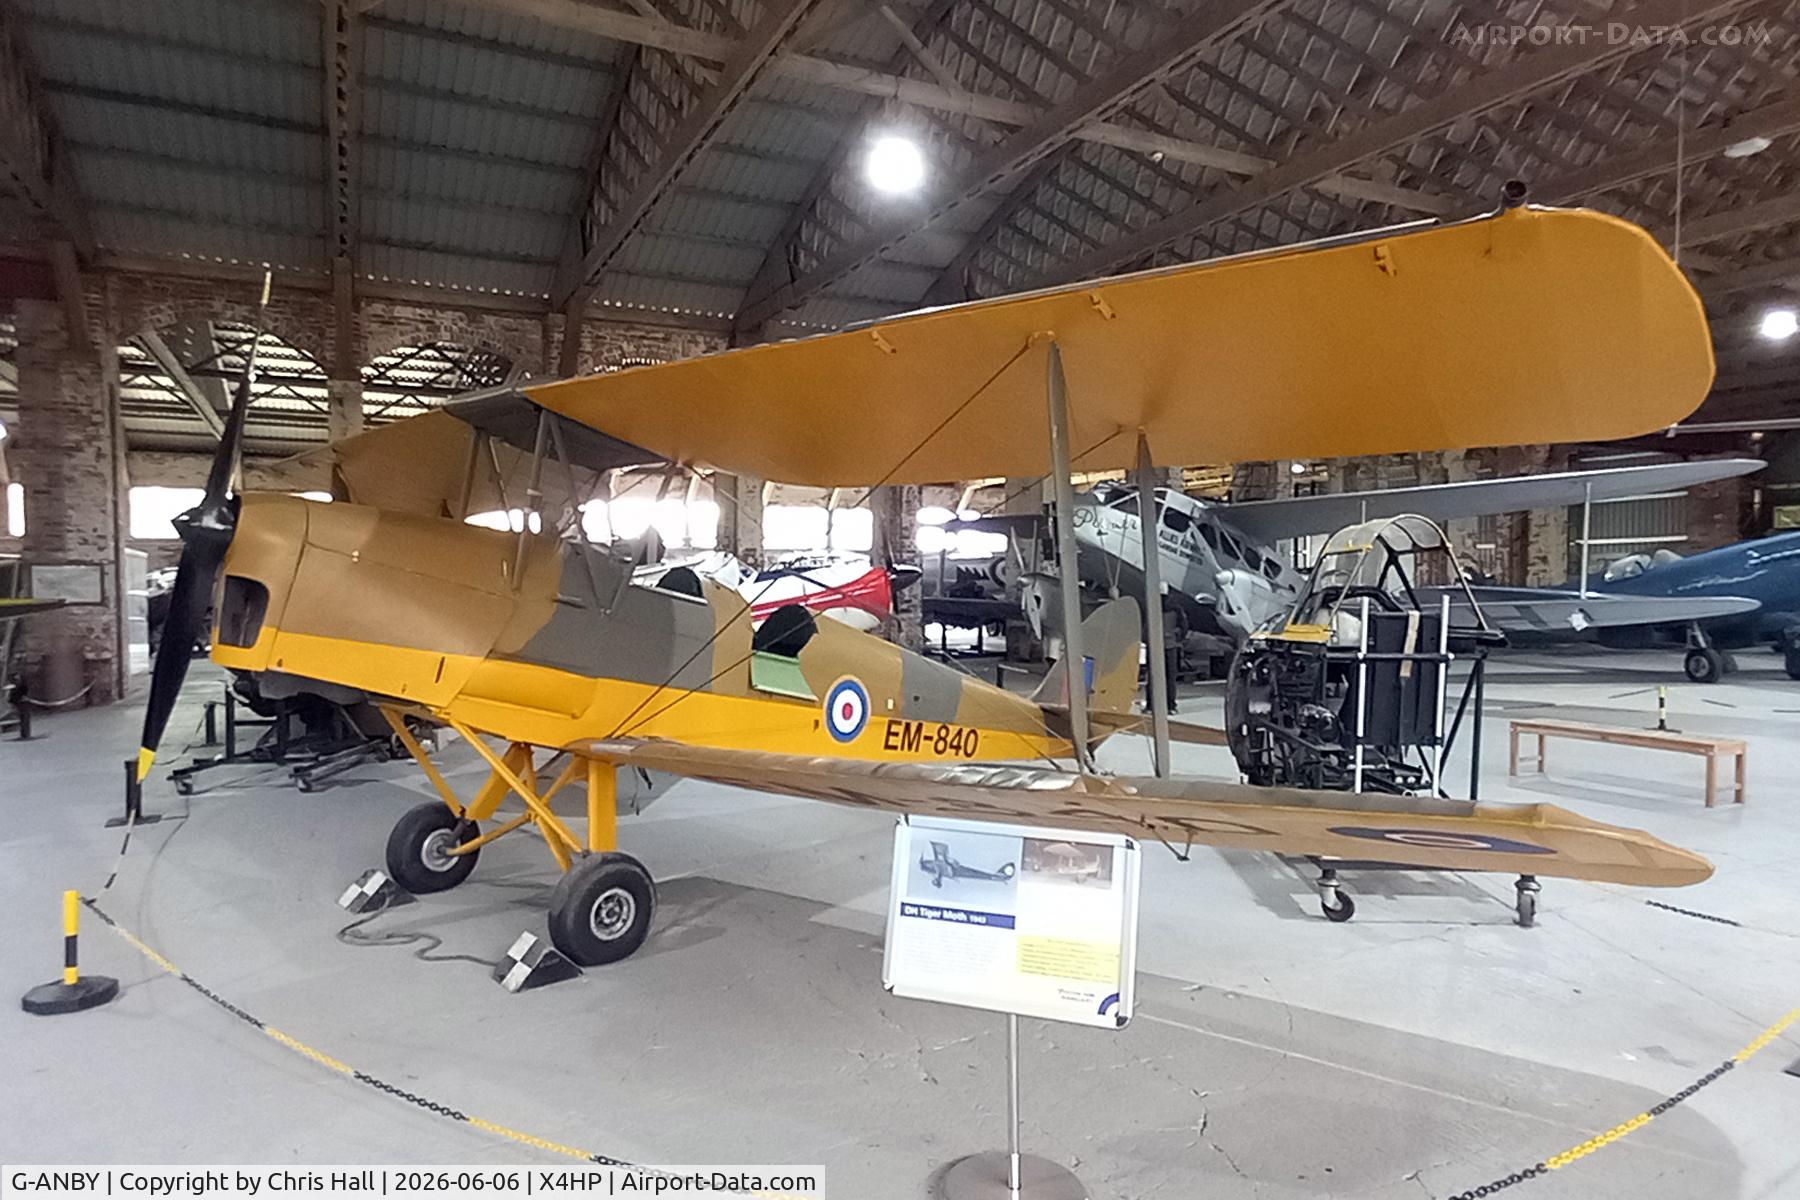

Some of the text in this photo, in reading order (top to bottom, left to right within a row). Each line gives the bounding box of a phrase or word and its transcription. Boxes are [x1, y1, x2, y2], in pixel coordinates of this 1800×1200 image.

[883, 719, 979, 758] EM-840
[904, 905, 919, 917] DH
[920, 907, 942, 919] Tiger
[943, 910, 968, 922] Moth
